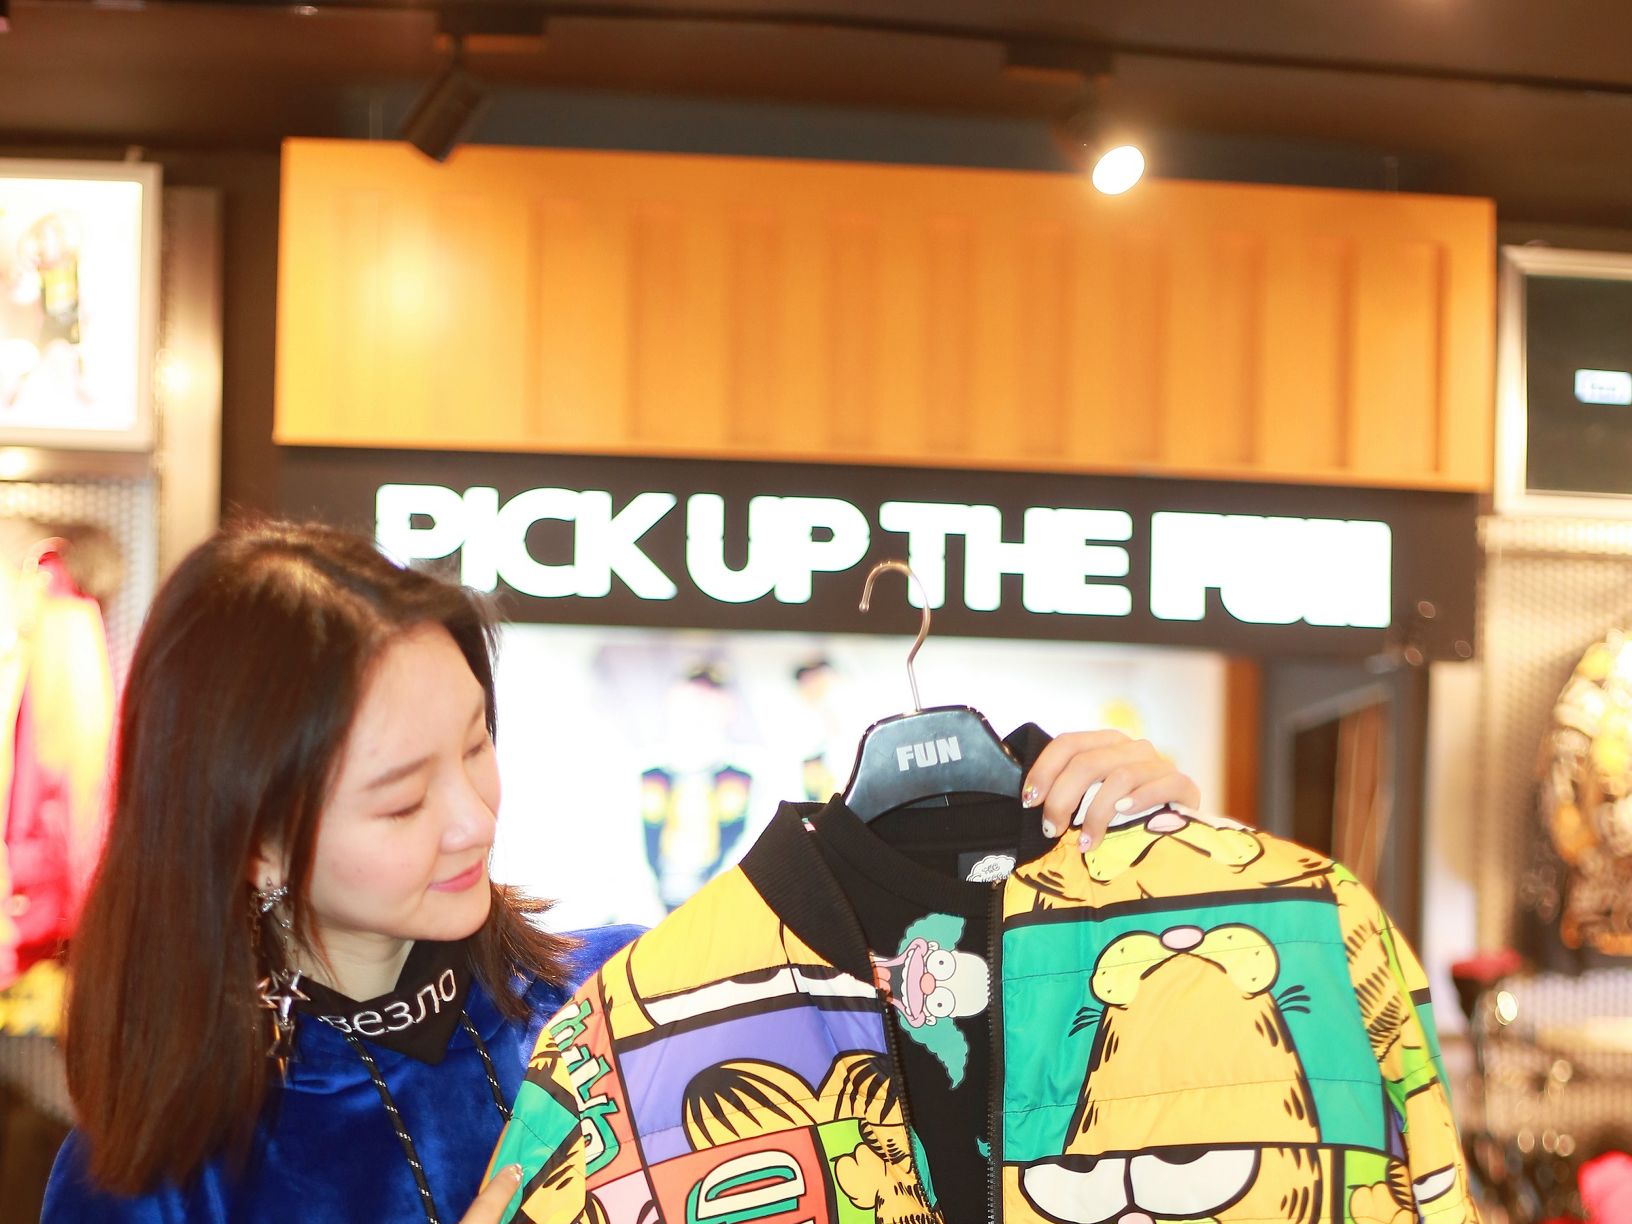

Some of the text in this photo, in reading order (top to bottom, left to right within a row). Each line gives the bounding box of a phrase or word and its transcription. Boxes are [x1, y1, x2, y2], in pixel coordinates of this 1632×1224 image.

[376, 484, 677, 600] PICK
[686, 493, 871, 604] UP
[879, 501, 1133, 617] THE
[896, 736, 961, 771] FUN
